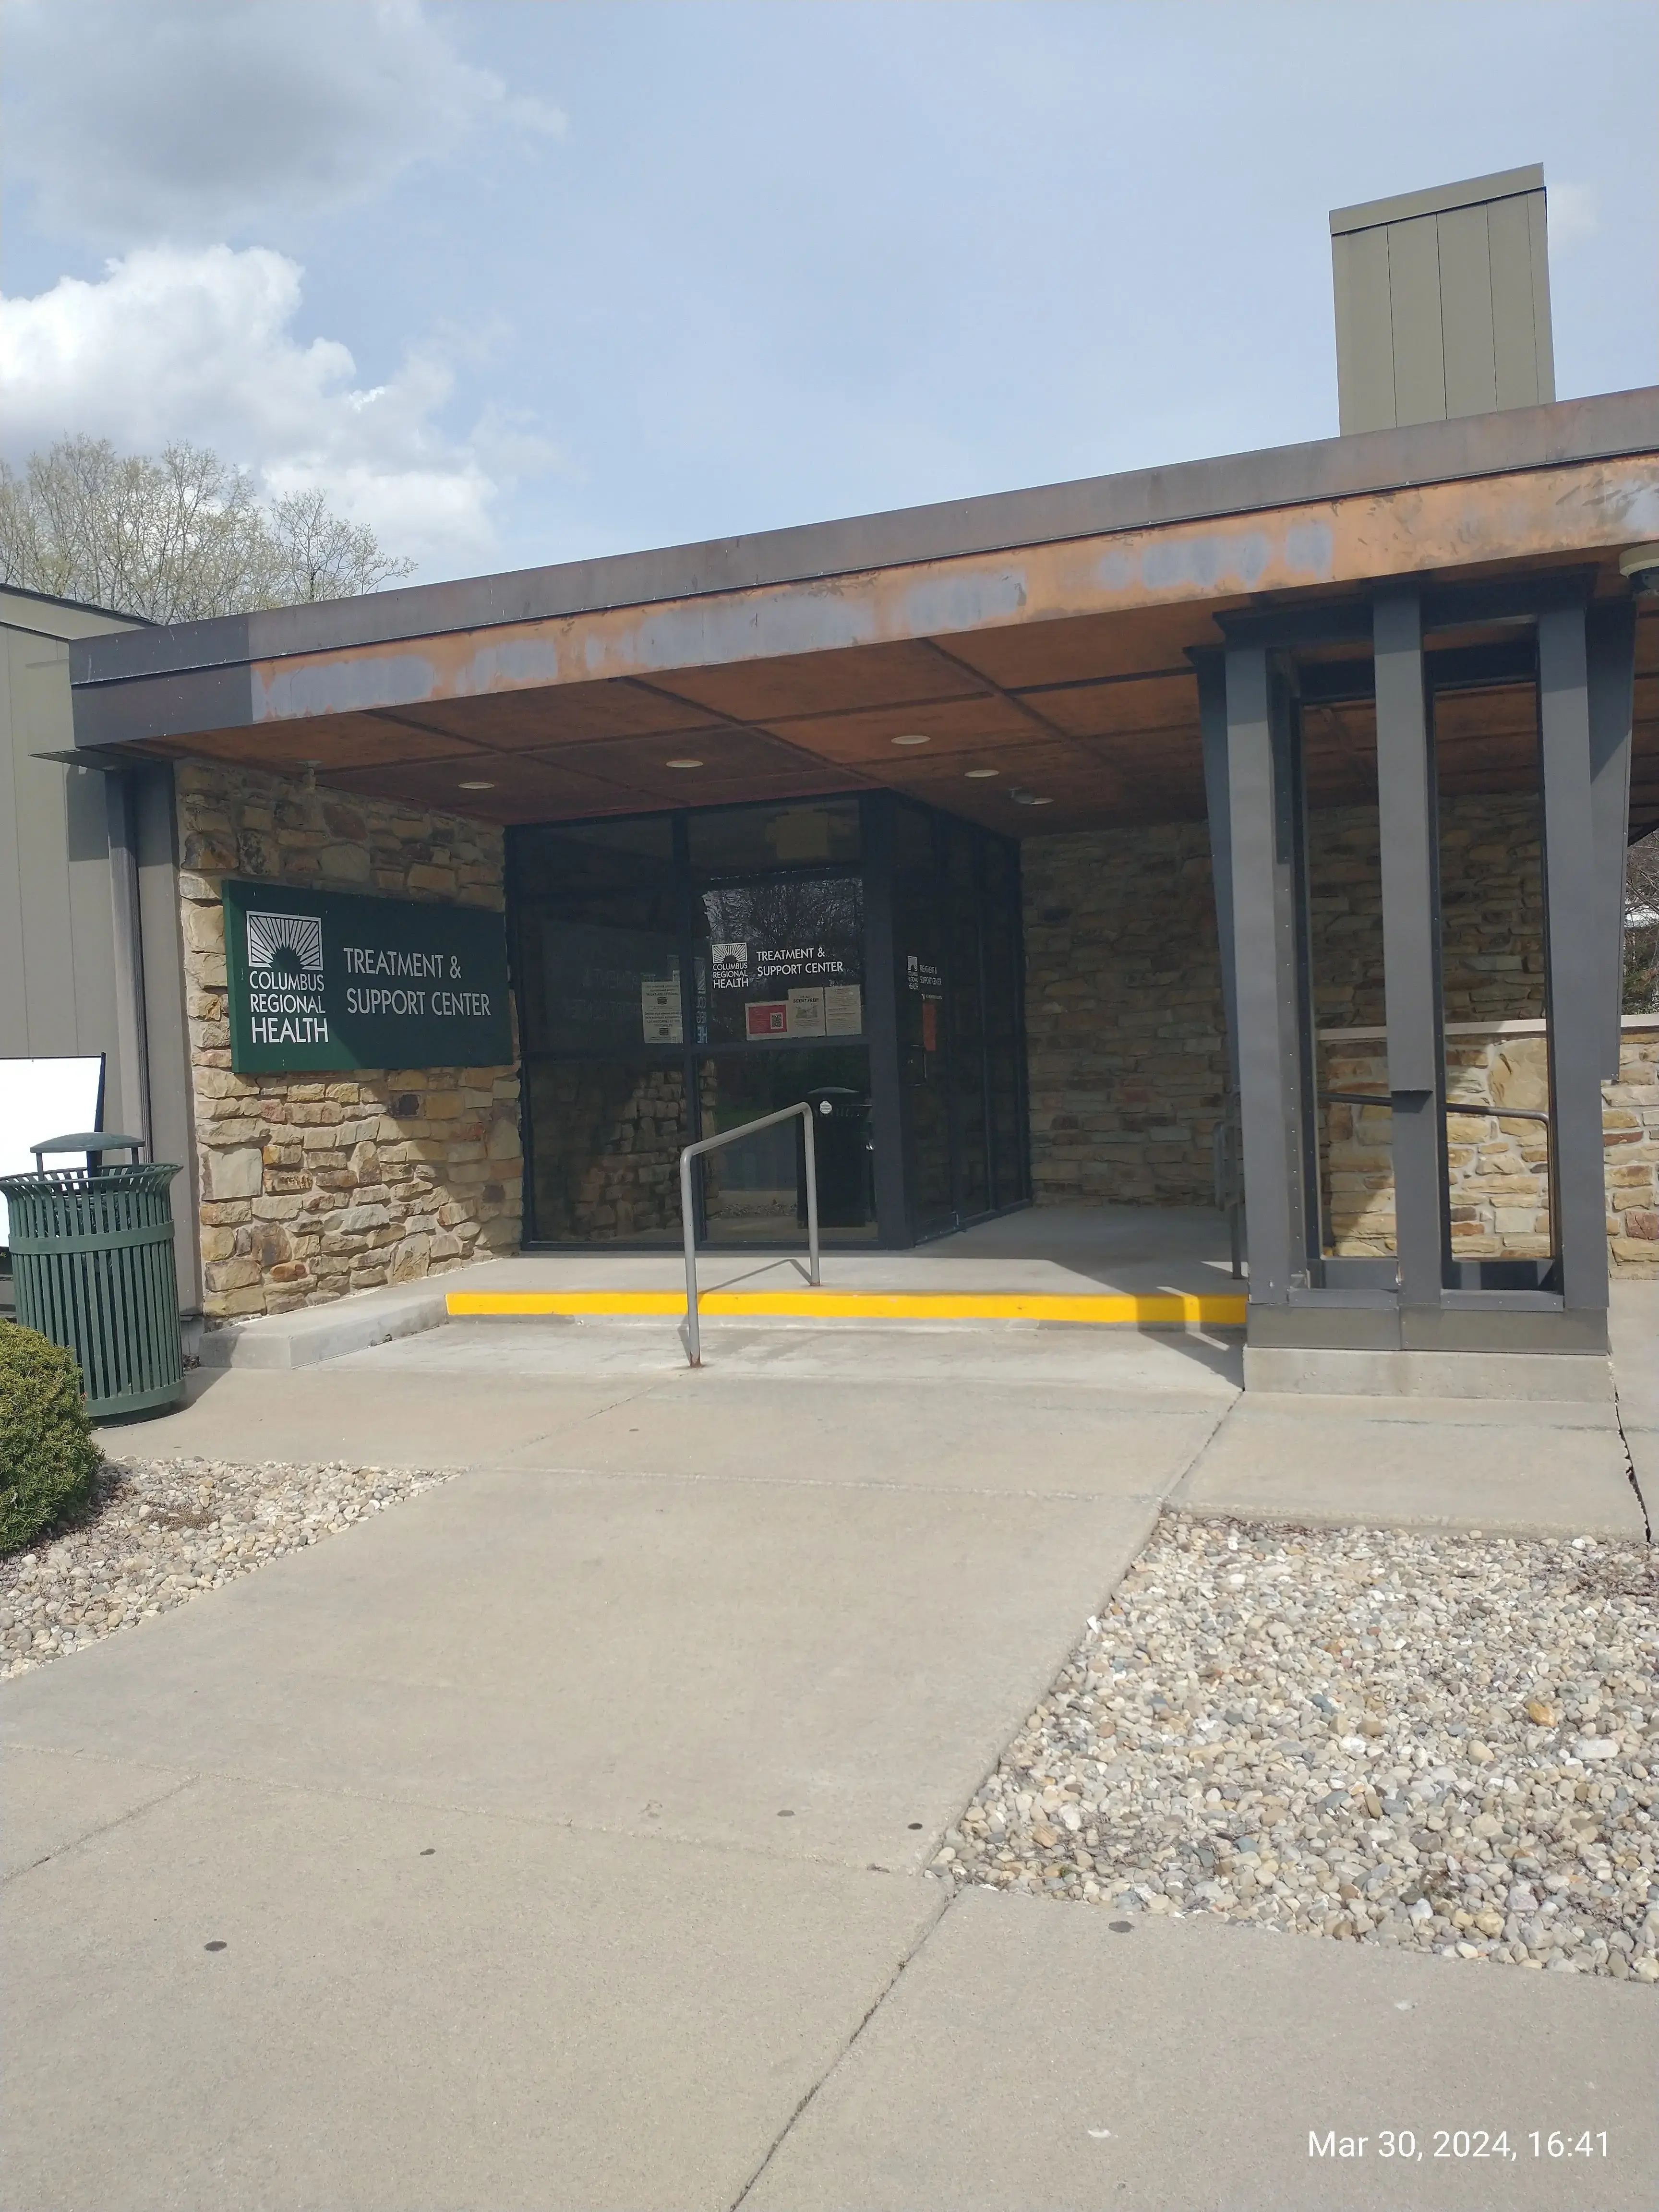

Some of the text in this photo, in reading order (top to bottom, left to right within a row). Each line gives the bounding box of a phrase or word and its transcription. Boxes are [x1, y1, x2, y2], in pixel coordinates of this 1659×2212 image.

[343, 948, 461, 979] TREATMENT &
[757, 947, 825, 962] TREATMENT &
[713, 962, 747, 971] COLUMBUS
[713, 970, 748, 978] REGIONAL
[757, 962, 843, 976] SUPPORT CENTER
[249, 971, 325, 992] COLUMBUS
[713, 978, 749, 989] HEALTH
[251, 993, 326, 1014] REGIONAL
[347, 988, 491, 1016] SUPPORT CENTER
[252, 1017, 328, 1043] HEALTH
